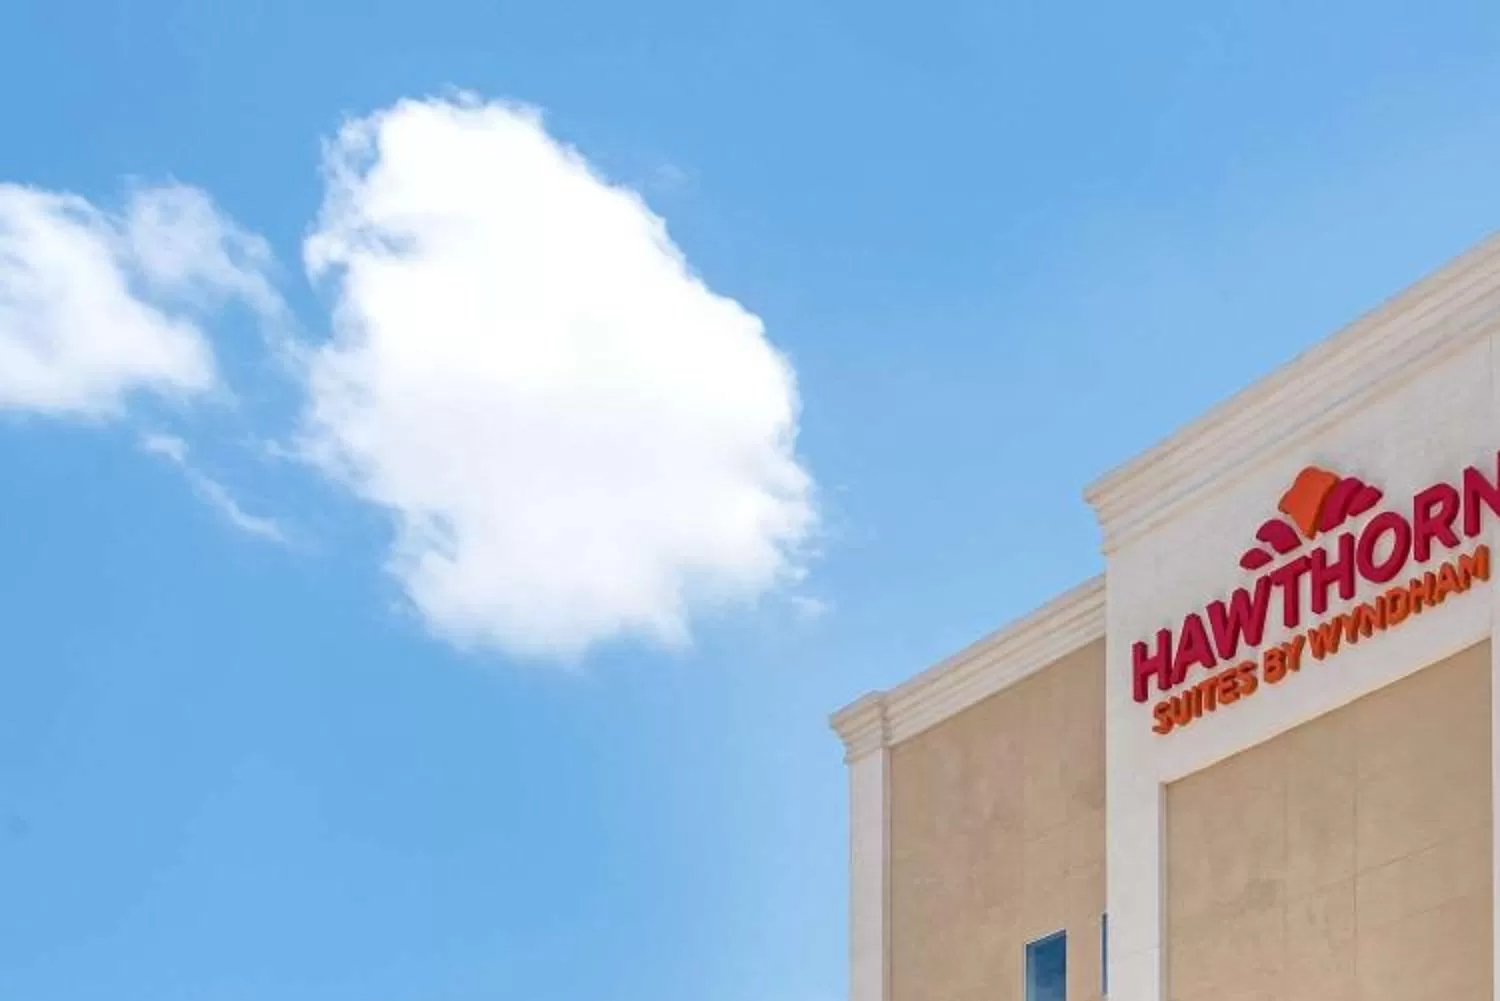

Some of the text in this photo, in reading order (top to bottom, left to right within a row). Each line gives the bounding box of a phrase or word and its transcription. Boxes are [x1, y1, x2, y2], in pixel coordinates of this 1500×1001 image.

[1152, 544, 1491, 735] SUITES BY WYNDHAM
